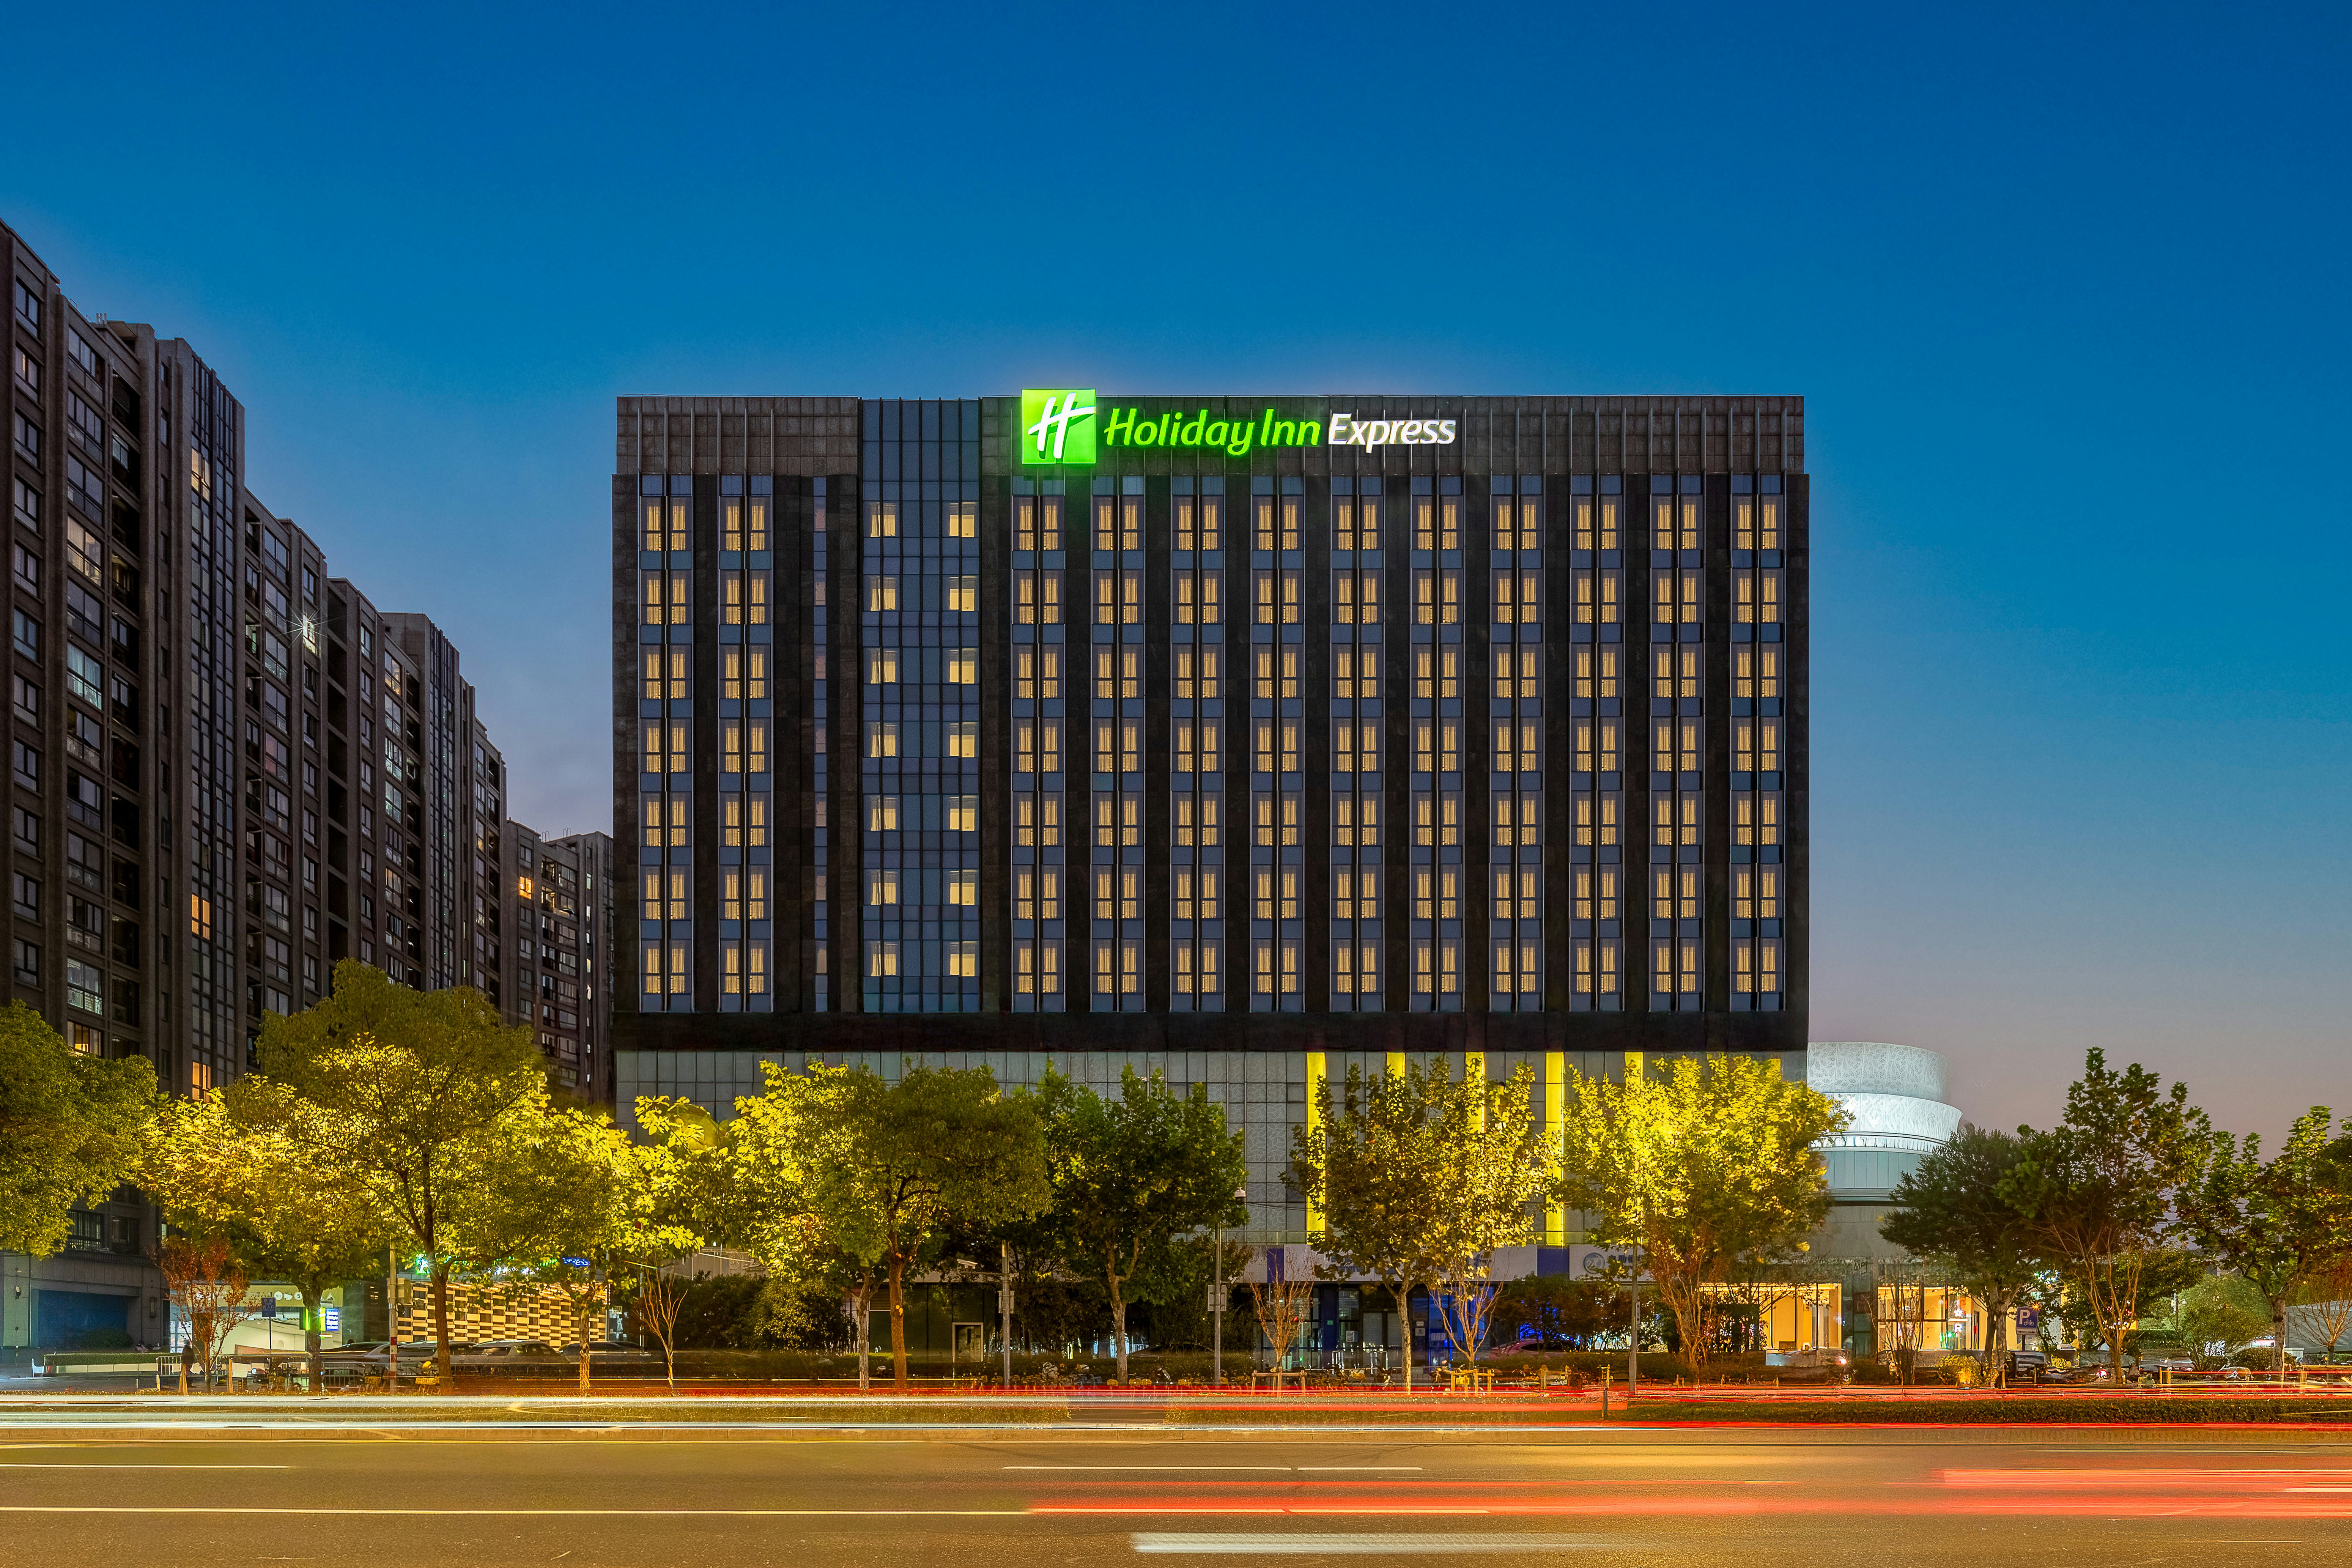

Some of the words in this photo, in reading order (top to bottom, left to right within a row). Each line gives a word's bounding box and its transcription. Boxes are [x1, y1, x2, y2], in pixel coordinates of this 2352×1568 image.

[1104, 408, 1255, 455] Holiday
[1261, 409, 1321, 446] Inn
[1329, 413, 1456, 453] Express
[2019, 1310, 2030, 1324] P
